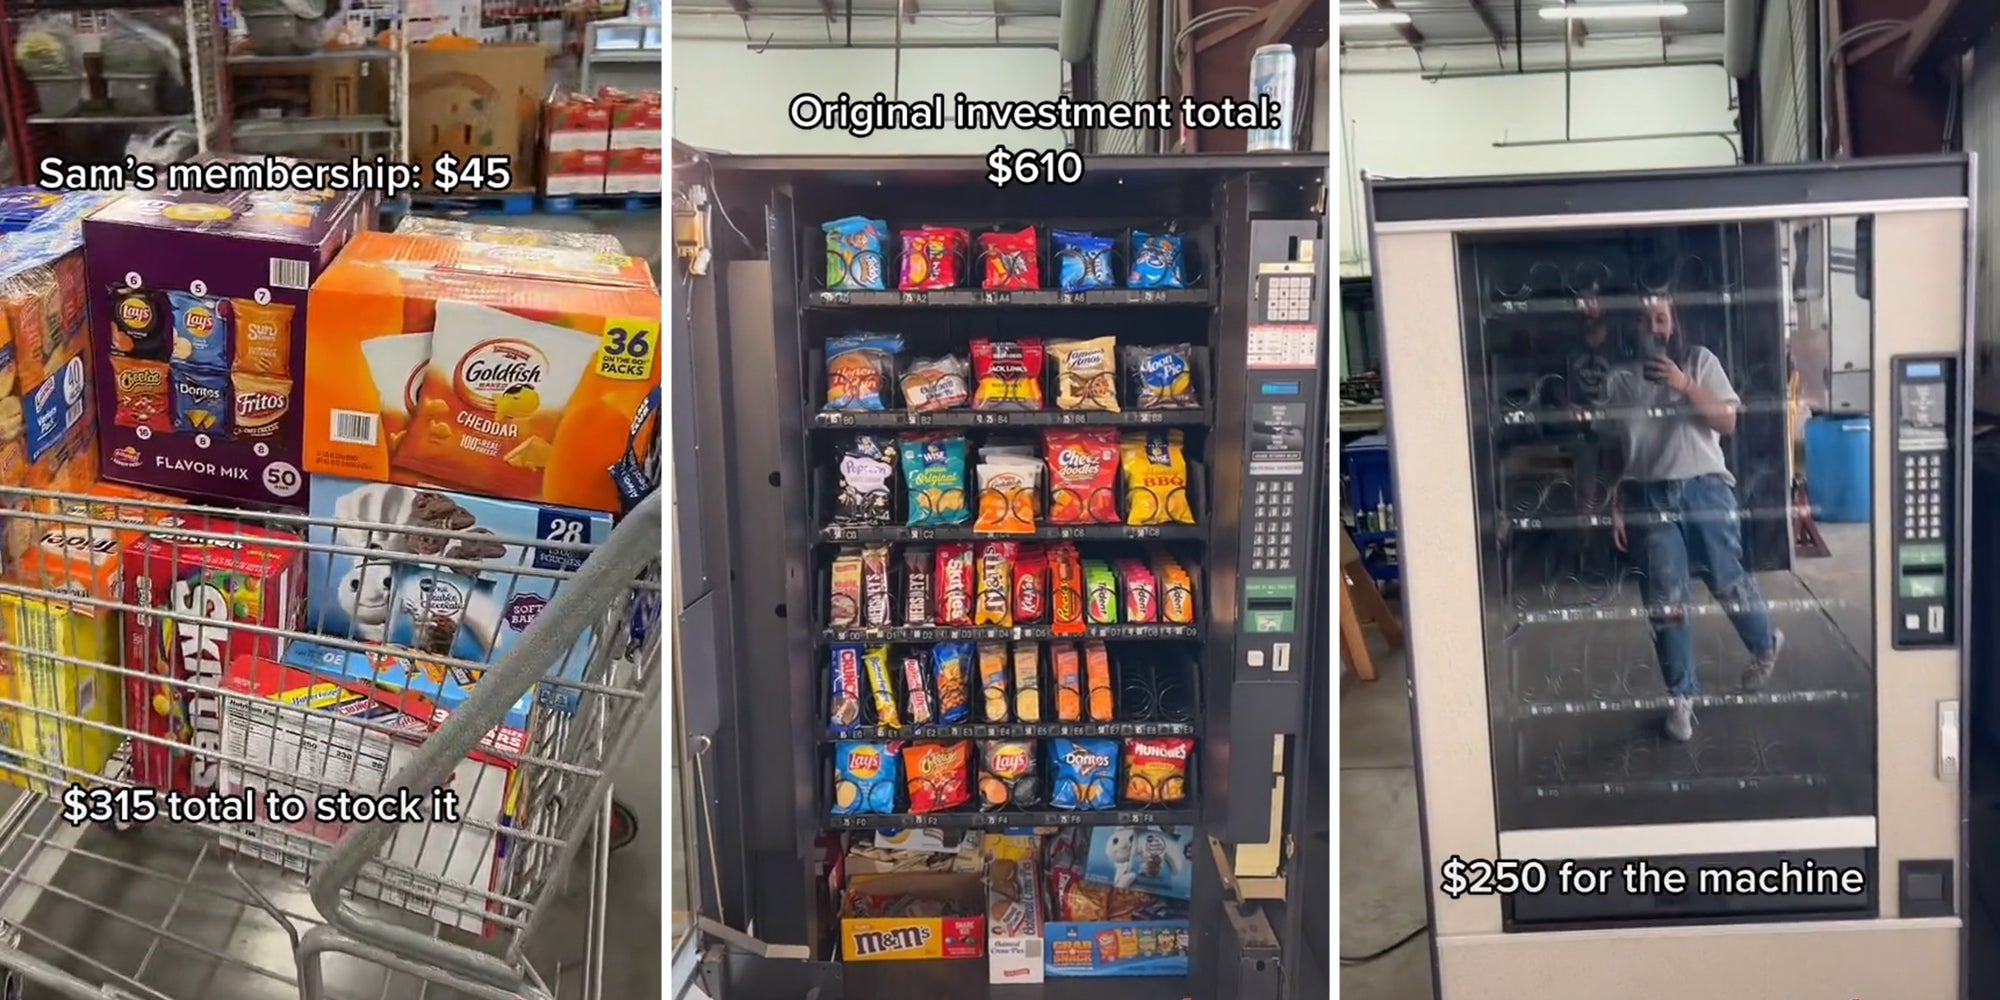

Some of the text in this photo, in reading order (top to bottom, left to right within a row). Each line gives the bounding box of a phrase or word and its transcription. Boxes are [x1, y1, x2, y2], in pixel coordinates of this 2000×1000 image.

[130, 275, 137, 285] 6
[195, 284, 201, 293] 5
[259, 291, 267, 301] 7
[604, 328, 649, 358] 36
[465, 360, 541, 383] Goldfish
[601, 363, 645, 376] PACKS
[1140, 355, 1173, 374] Moon
[1164, 362, 1184, 377] Pie
[237, 392, 284, 416] Fritos
[456, 411, 518, 437] CHEDDAR
[156, 456, 216, 475] FLAVOR
[220, 468, 249, 481] MIX
[268, 469, 296, 487] 50
[1143, 476, 1184, 487] BBQ
[546, 518, 584, 543] 28
[513, 604, 543, 614] SOFT
[1066, 754, 1109, 767] Doritos
